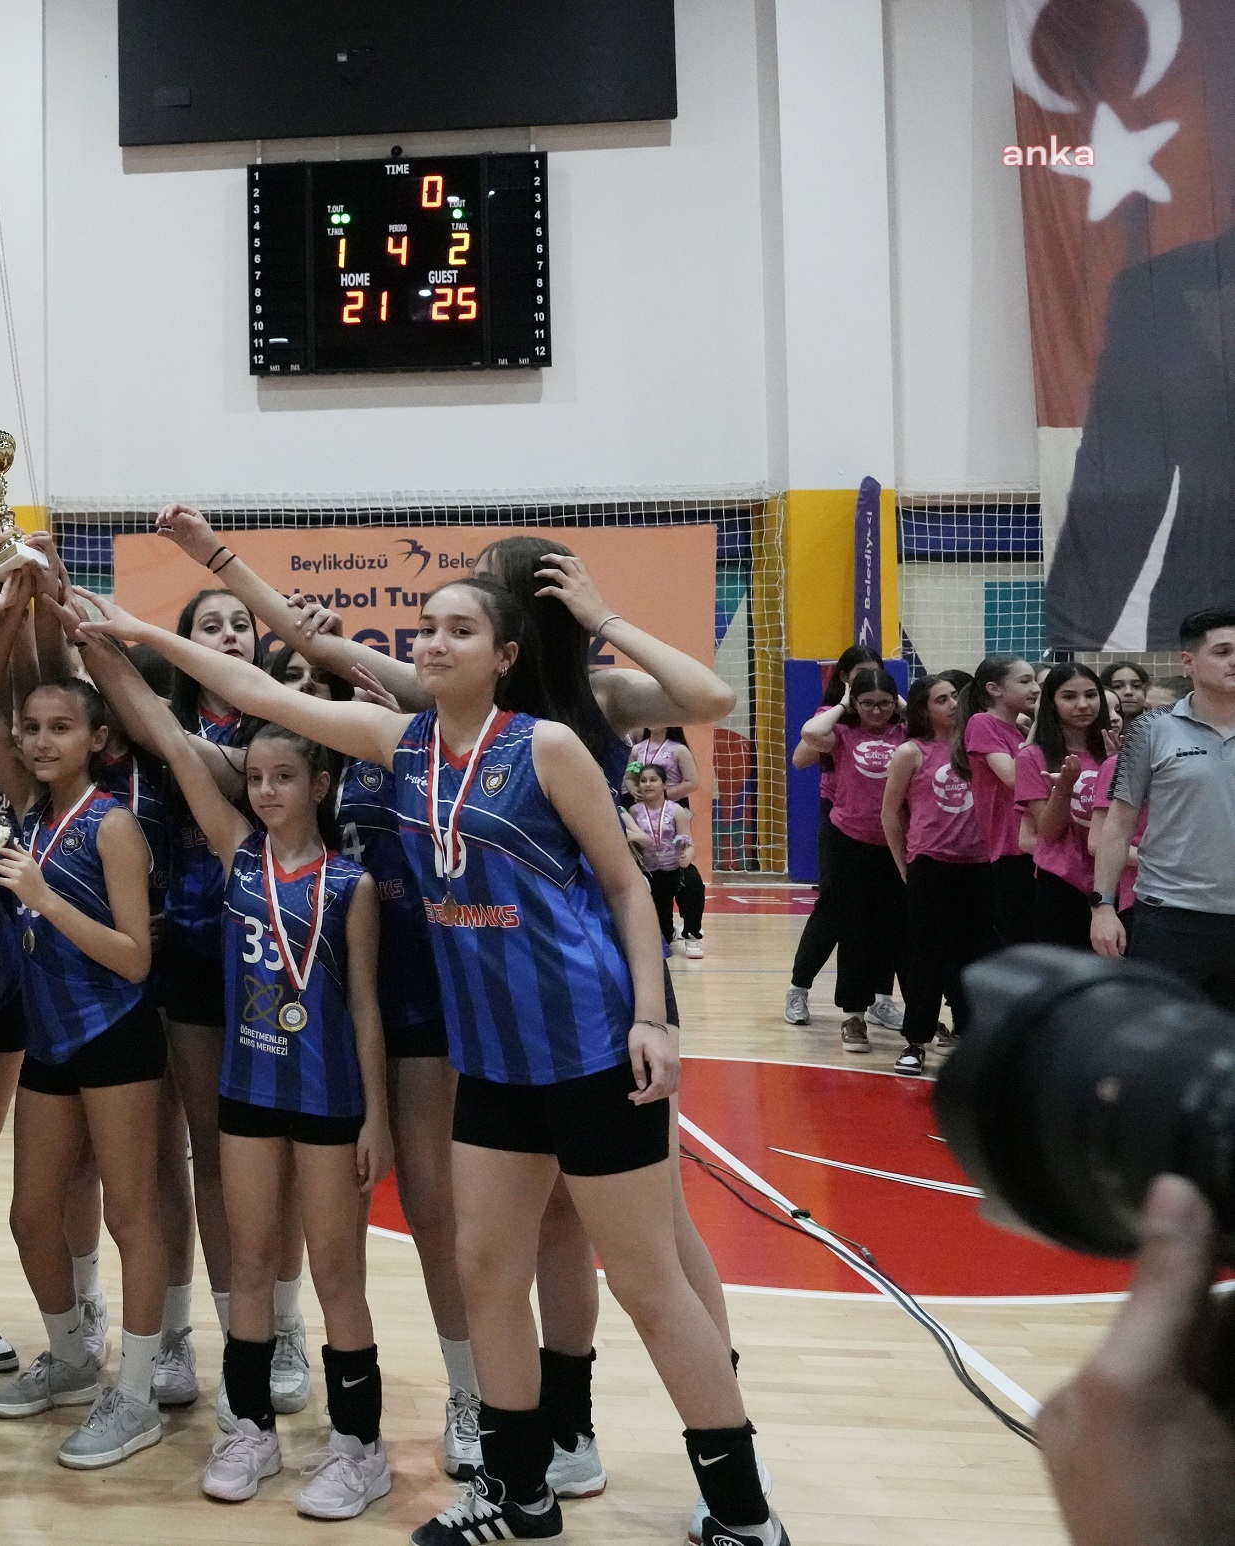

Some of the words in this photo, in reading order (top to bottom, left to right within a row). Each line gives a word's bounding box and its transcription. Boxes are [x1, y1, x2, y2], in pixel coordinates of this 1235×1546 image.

[385, 164, 410, 175] TIME
[533, 176, 540, 186] 2
[254, 188, 260, 197] 2
[421, 175, 443, 208] 0
[534, 193, 541, 203] 3
[254, 204, 260, 214] 3
[327, 205, 344, 214] T.OUT
[533, 210, 541, 220] 4
[253, 221, 261, 230] 4
[388, 224, 408, 233] PERIOD
[451, 222, 469, 231] T.FAUL
[327, 228, 344, 236] T.FAUL
[535, 227, 543, 237] 5
[254, 238, 261, 247] 5
[337, 237, 346, 269] 1
[386, 235, 408, 266] 4
[448, 232, 471, 266] 2
[536, 244, 544, 253] 6
[254, 254, 261, 264] 6
[536, 261, 544, 270] 7
[254, 271, 261, 280] 7
[340, 273, 370, 287] HOME
[428, 270, 458, 285] GUEST
[536, 278, 544, 288] 8
[255, 287, 262, 297] 8
[431, 286, 477, 321] 25
[536, 295, 544, 304] 9
[255, 304, 263, 314] 9
[533, 312, 545, 321] 10
[253, 321, 264, 330] 10
[534, 329, 545, 338] 11
[253, 338, 264, 347] 11
[534, 346, 546, 355] 12
[253, 355, 264, 364] 12
[291, 553, 388, 574] Beylikdüzü
[438, 552, 474, 569] Bele
[240, 1023, 288, 1046] ÖĞRETMENLER
[239, 1035, 256, 1048] KURS
[256, 1041, 288, 1056] MERKEZİ
